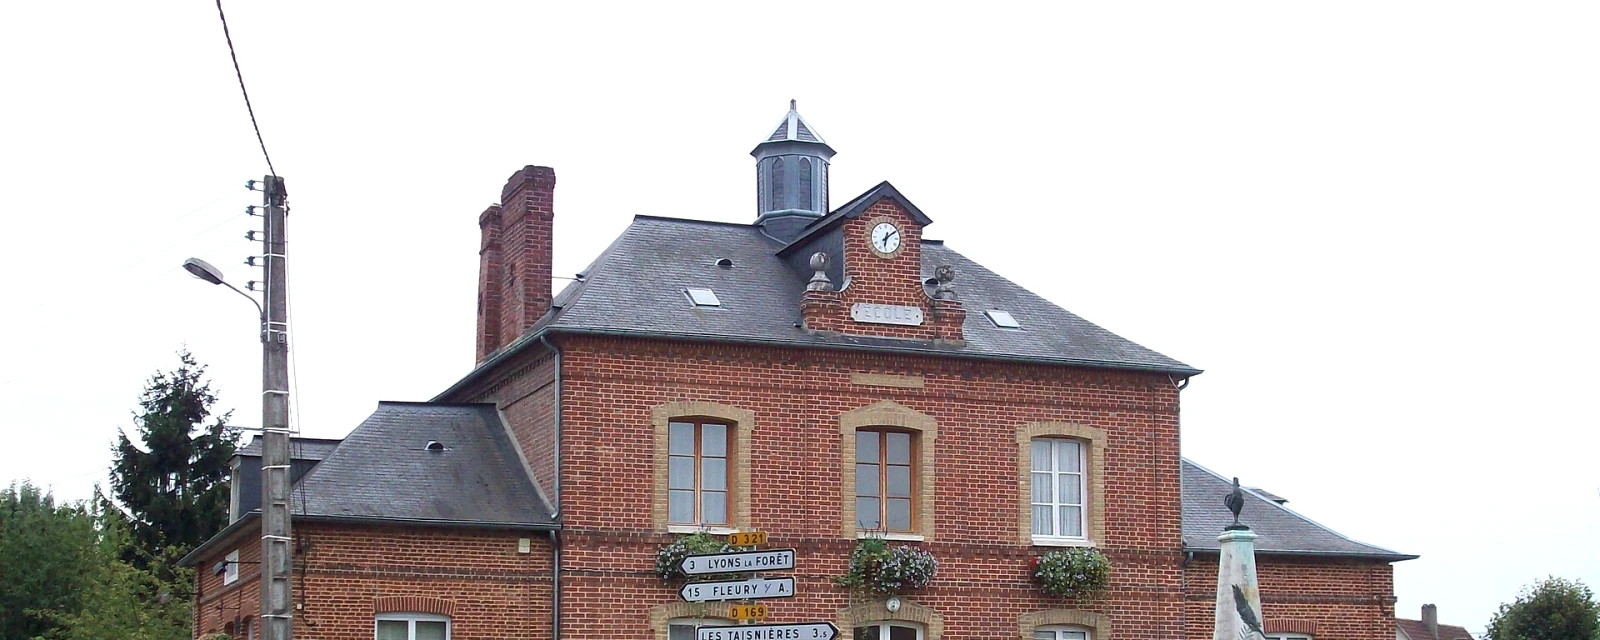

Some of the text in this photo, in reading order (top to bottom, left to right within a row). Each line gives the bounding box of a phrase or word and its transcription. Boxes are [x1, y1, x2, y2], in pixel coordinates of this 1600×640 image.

[863, 305, 912, 321] ECOLE
[731, 533, 764, 545] D 321
[689, 560, 696, 570] 3
[708, 557, 741, 569] LYONS
[755, 553, 789, 567] FORÊT
[688, 587, 700, 597] 15
[713, 584, 758, 596] FLEURY
[731, 607, 765, 618] D 169
[701, 631, 722, 640] LES
[727, 627, 800, 640] TAISNIÈRES
